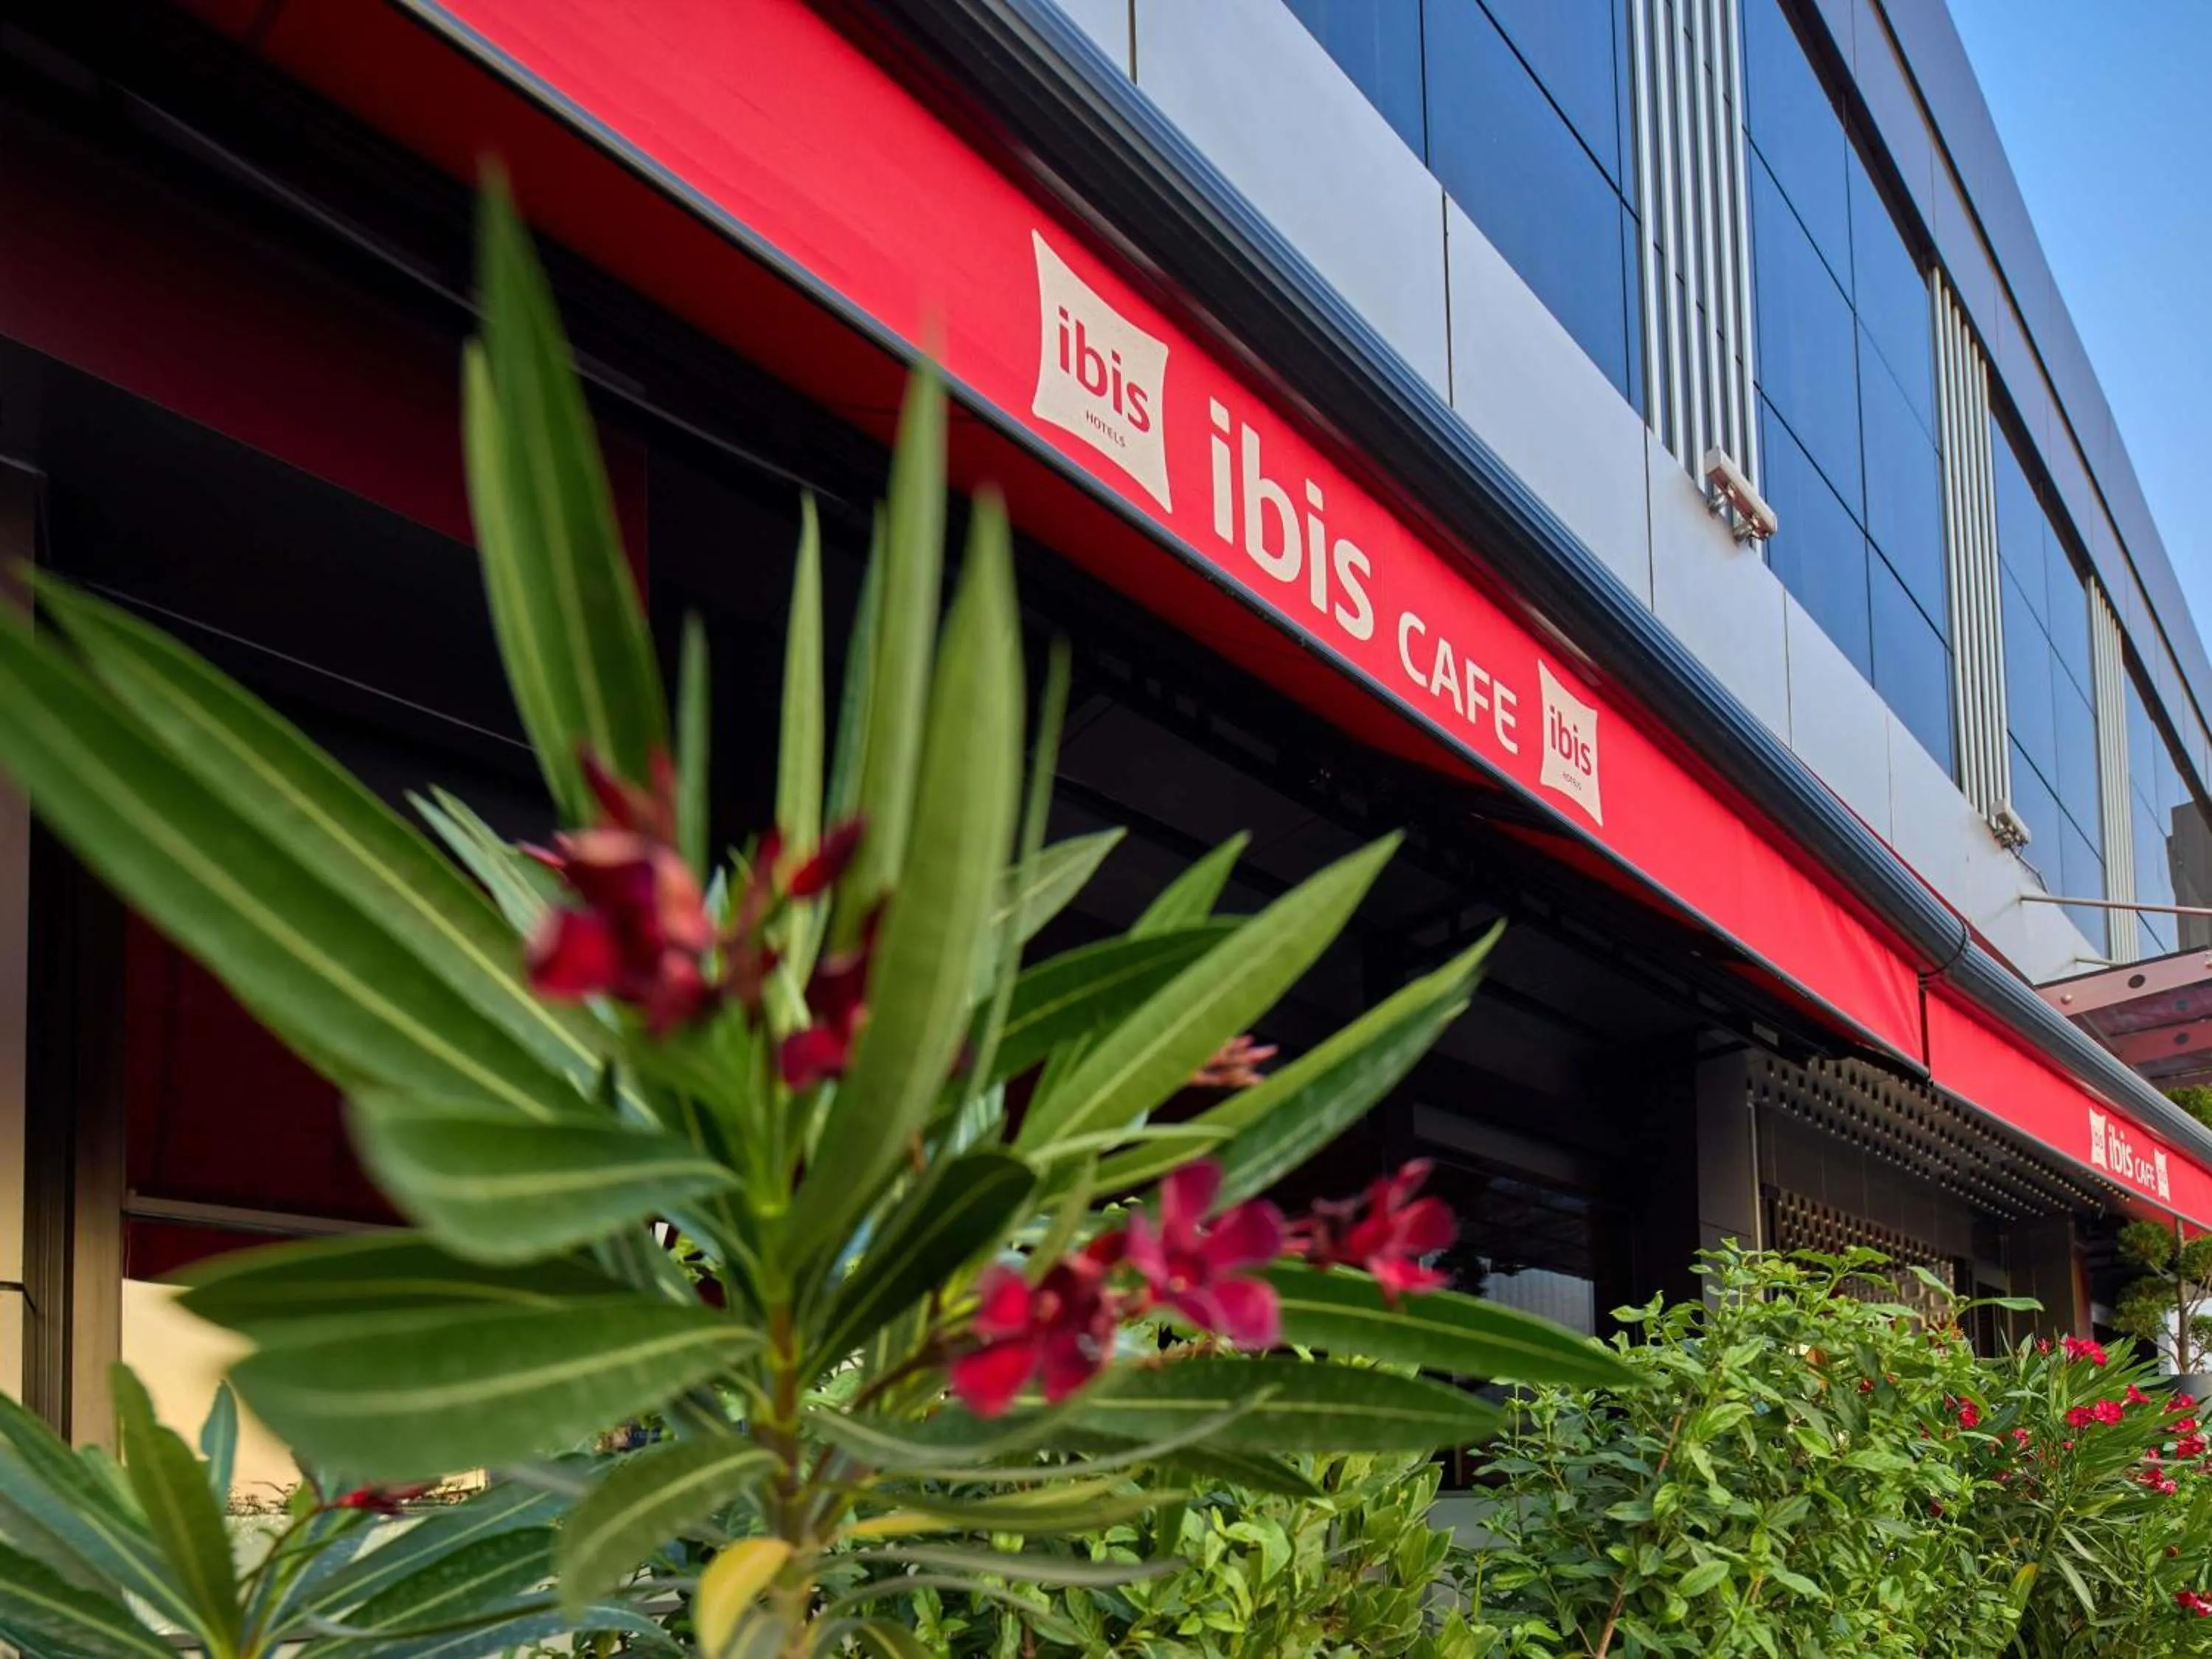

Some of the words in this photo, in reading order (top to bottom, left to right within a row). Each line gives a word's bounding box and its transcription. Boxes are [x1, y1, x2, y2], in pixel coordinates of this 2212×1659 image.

[1059, 306, 1150, 433] ibis
[1086, 410, 1126, 448] HOTELS
[1210, 396, 1374, 641] ibis
[1398, 611, 1518, 755] CAFE
[1550, 705, 1591, 776] ibis
[2108, 1123, 2133, 1179] ibis
[2135, 1157, 2157, 1191] CAFE
